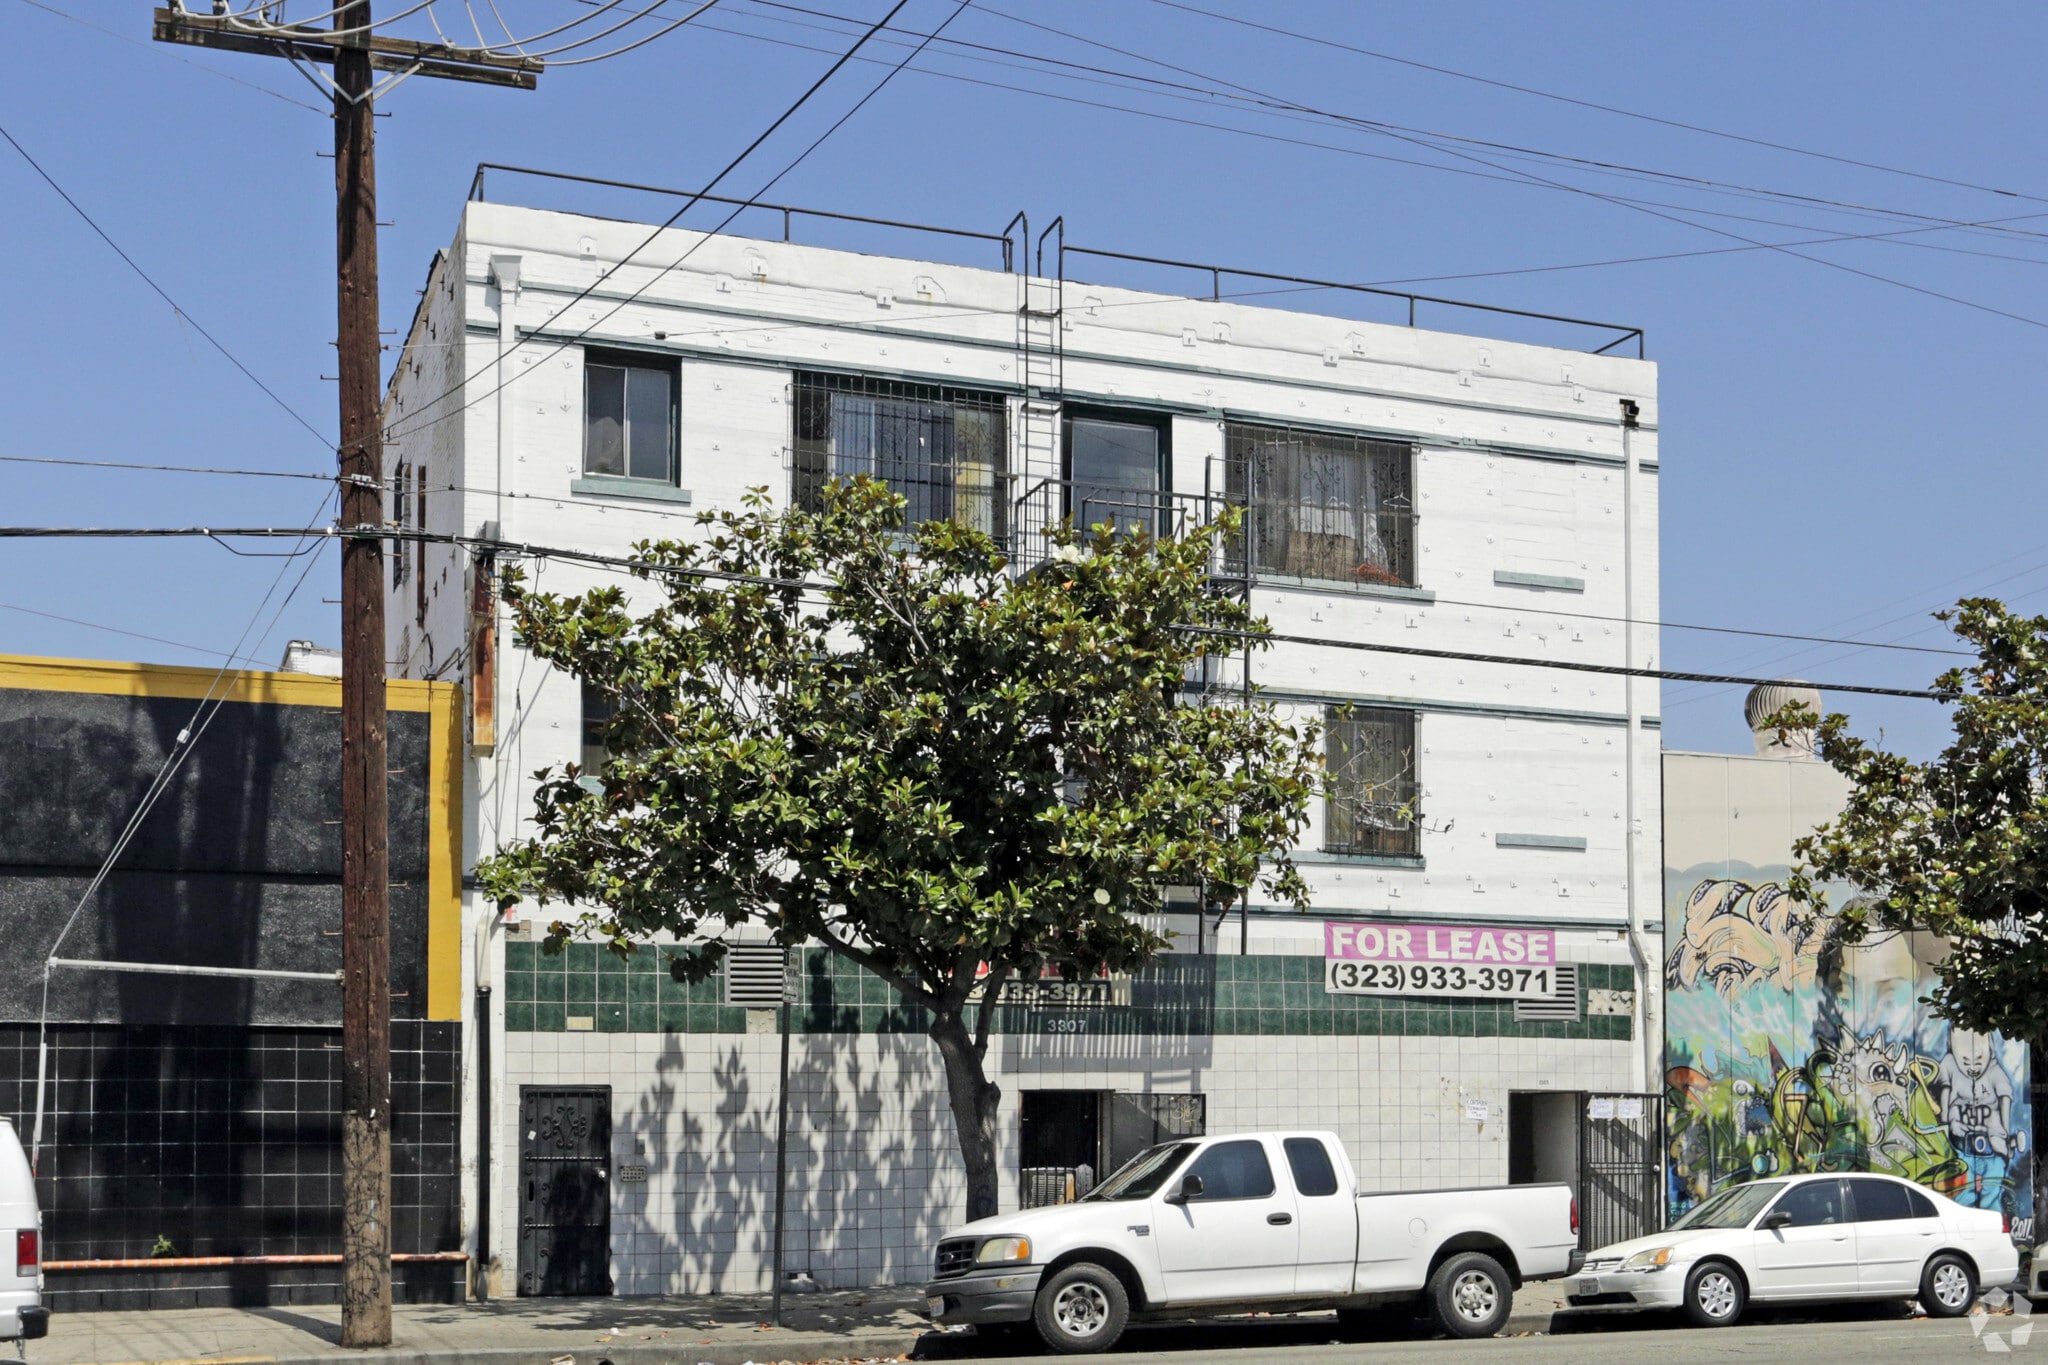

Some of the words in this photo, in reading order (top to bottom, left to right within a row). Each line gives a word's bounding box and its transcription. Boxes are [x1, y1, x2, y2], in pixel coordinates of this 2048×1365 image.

[1332, 926, 1414, 958] FOR
[1427, 930, 1550, 963] LEASE
[1331, 963, 1548, 993] (323)933-3971
[1047, 1019, 1087, 1032] 3307
